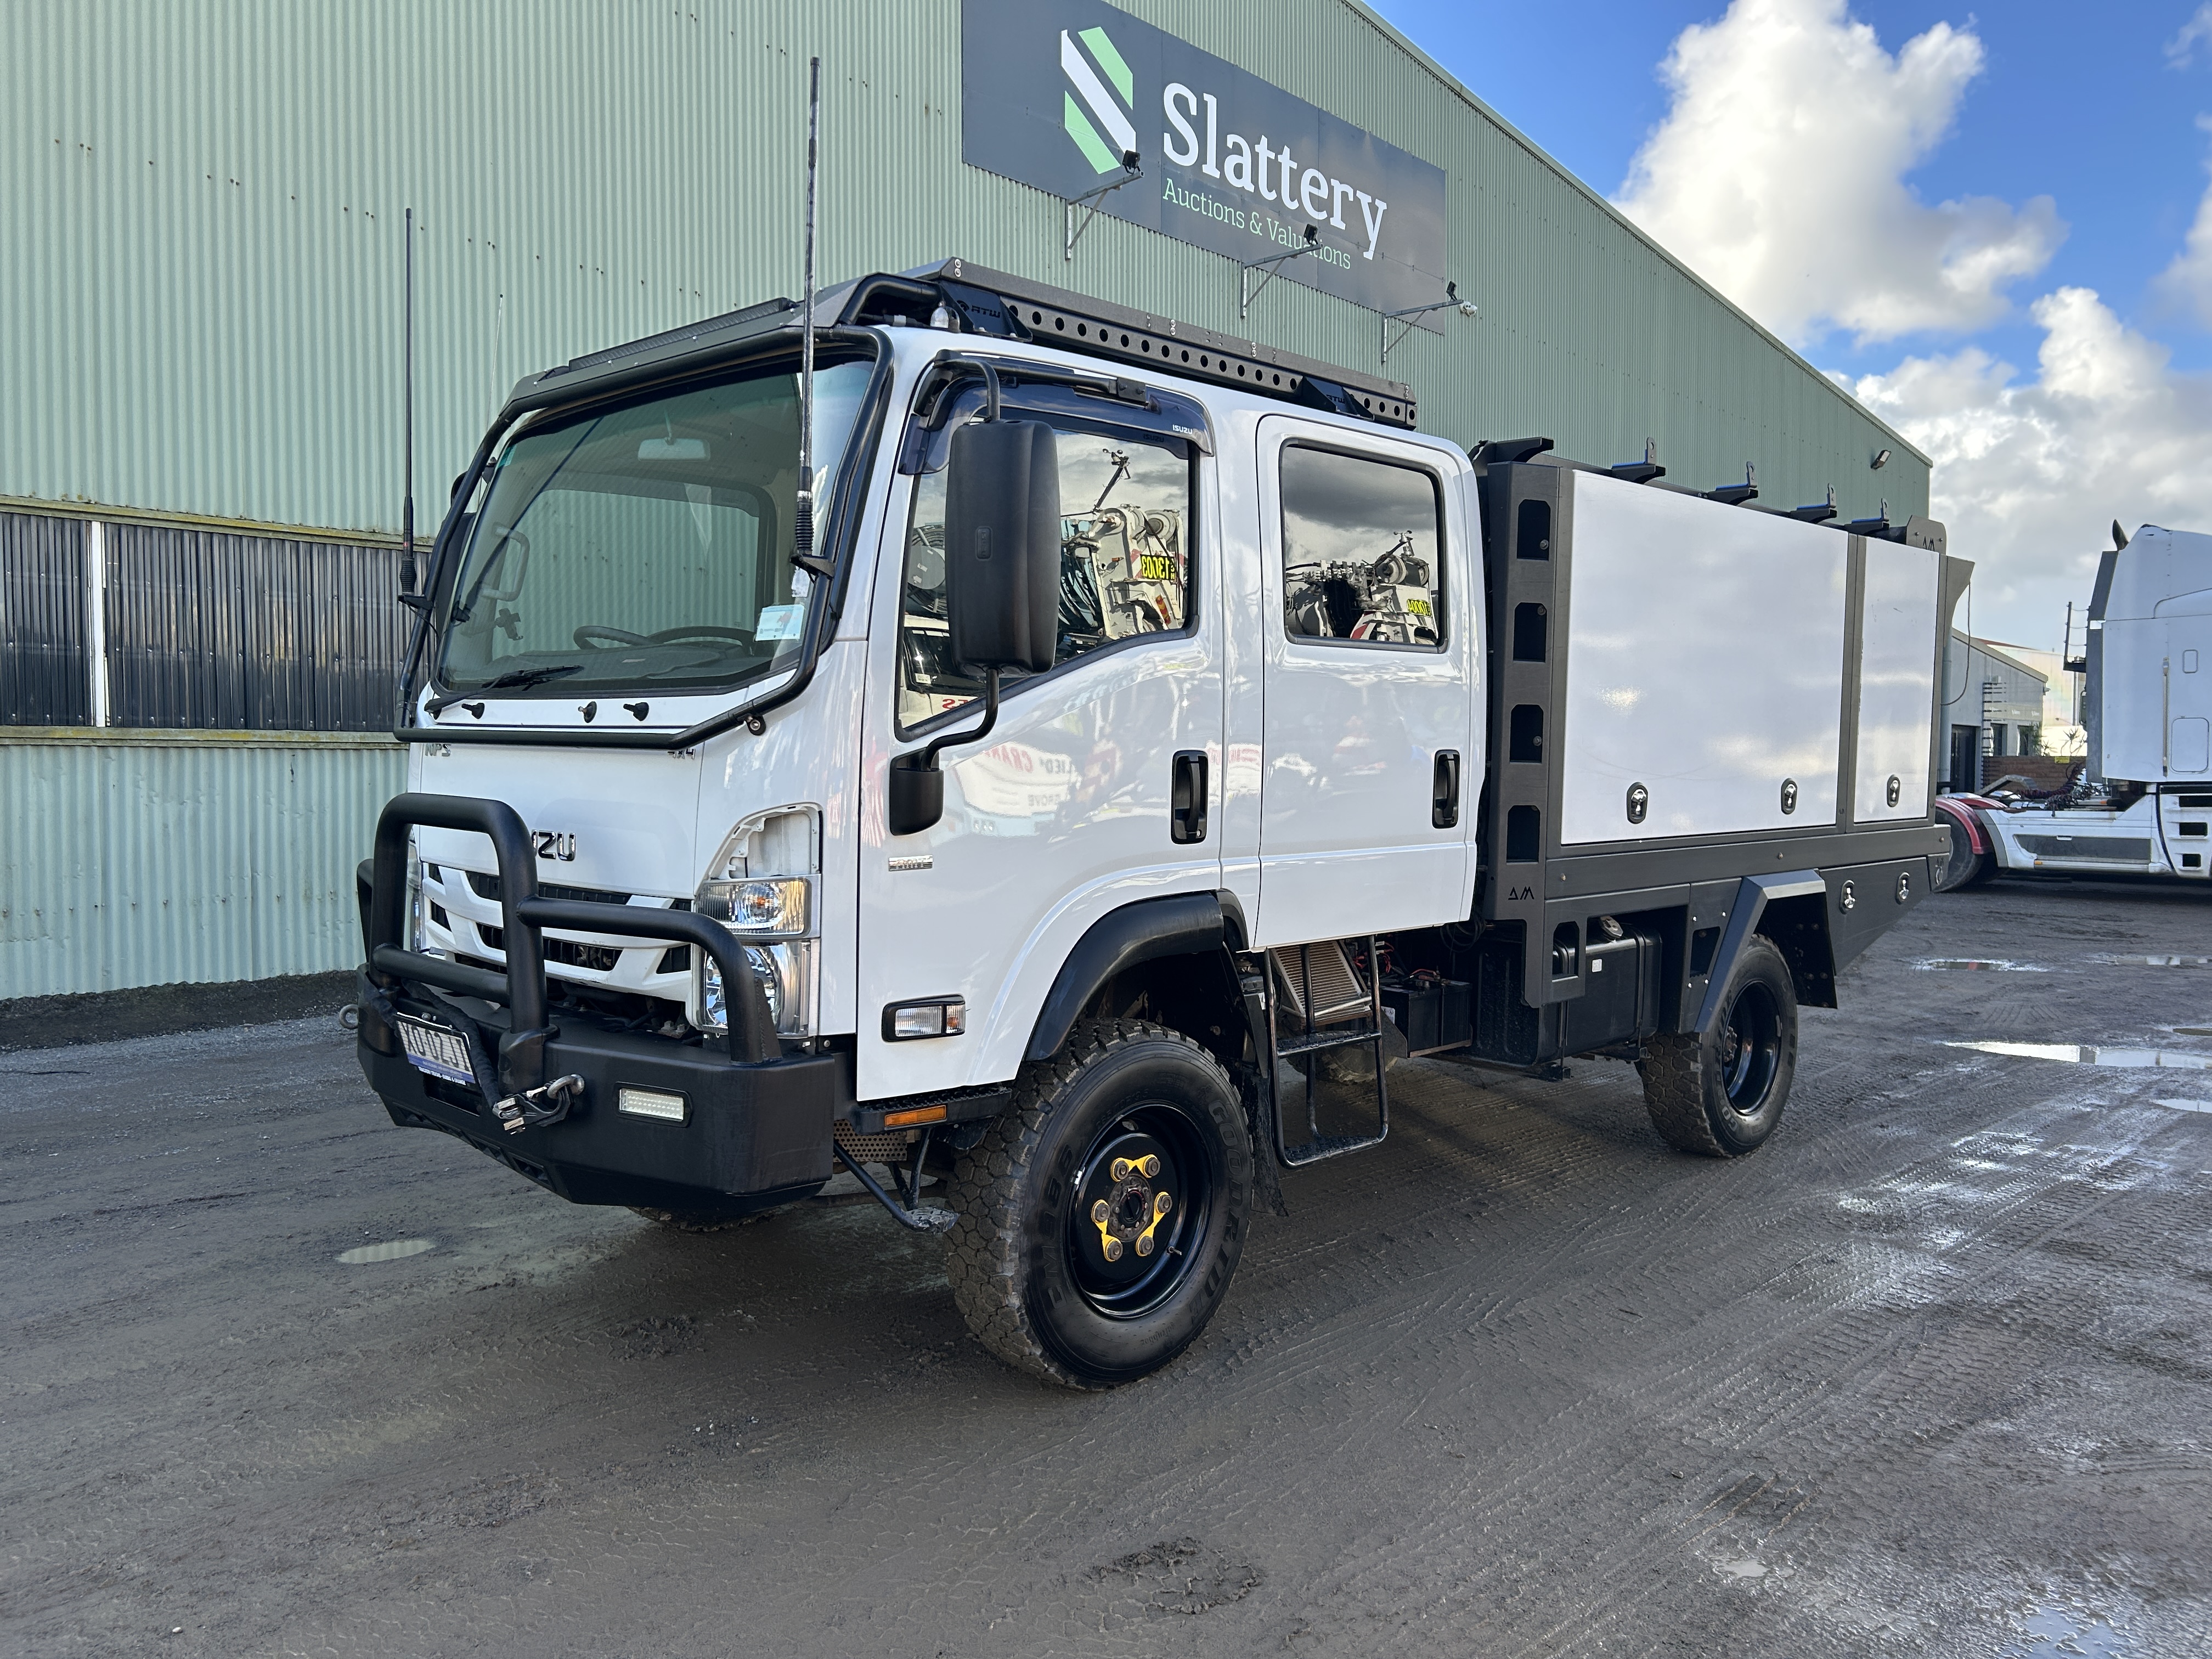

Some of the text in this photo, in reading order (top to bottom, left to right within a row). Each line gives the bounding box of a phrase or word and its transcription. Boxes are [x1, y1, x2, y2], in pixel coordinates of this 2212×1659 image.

[1163, 83, 1387, 260] Slattery
[1163, 178, 1245, 229] Auctions
[1250, 212, 1262, 236] &
[1172, 424, 1193, 434] ISUZU
[425, 743, 452, 757] NPS
[1187, 1099, 1244, 1325] GOODRIDE
